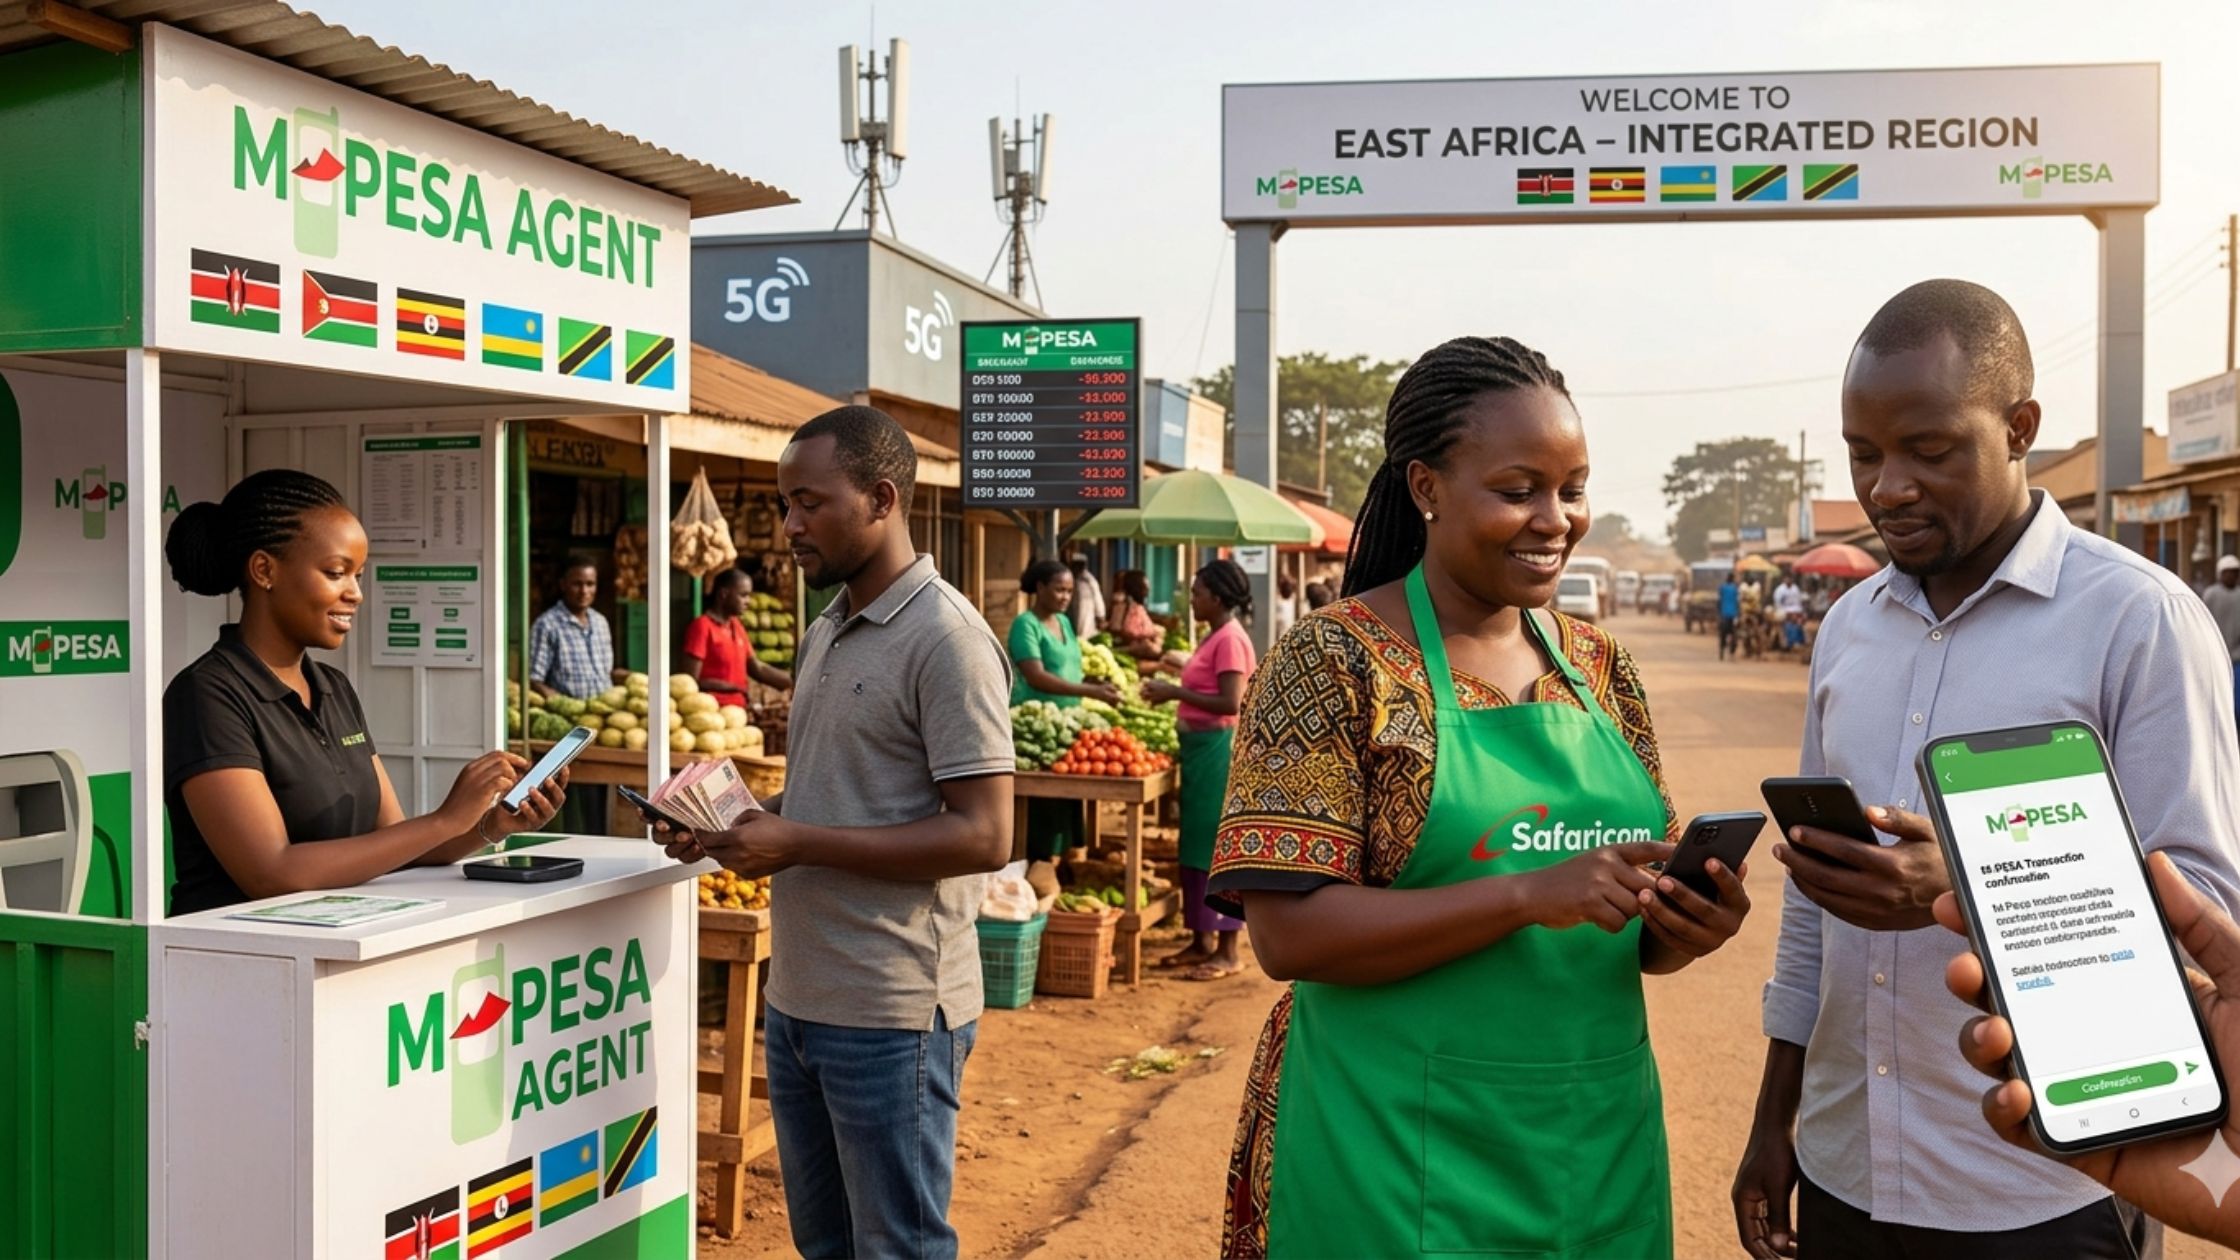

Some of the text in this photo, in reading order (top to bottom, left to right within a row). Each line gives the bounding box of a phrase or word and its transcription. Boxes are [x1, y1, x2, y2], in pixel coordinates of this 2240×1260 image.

[1580, 86, 1790, 112] WELCOME TO
[1334, 127, 1430, 159] EAST
[1441, 125, 1586, 158] AFRICA
[1628, 118, 1874, 155] INTEGRATED
[1888, 116, 2038, 150] REGION
[506, 188, 661, 289] AGENT
[724, 277, 790, 323] 5G
[904, 305, 942, 361] 5G
[1511, 820, 1651, 852] Safaricom
[512, 1020, 652, 1121] AGENT
